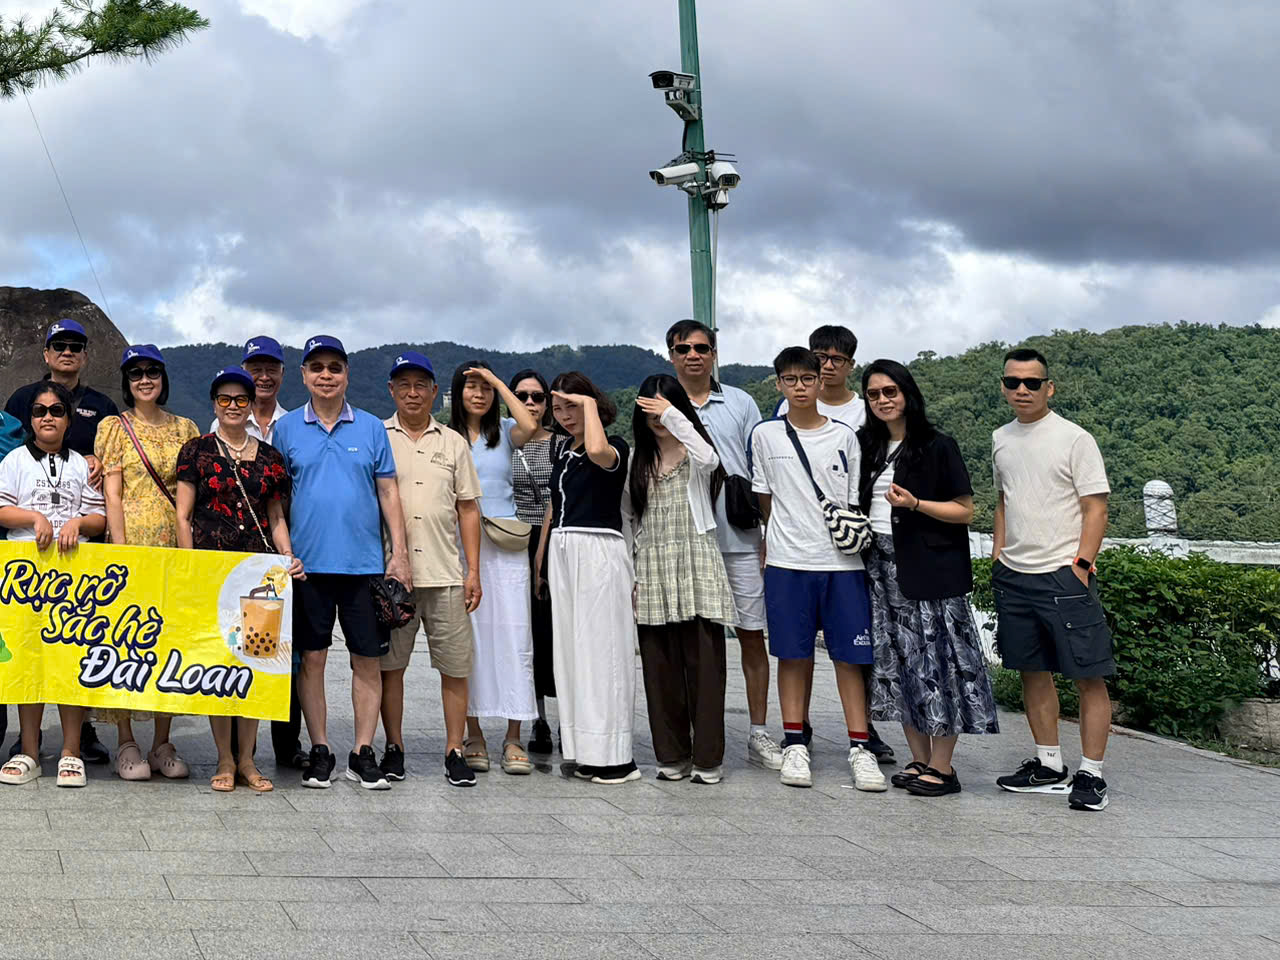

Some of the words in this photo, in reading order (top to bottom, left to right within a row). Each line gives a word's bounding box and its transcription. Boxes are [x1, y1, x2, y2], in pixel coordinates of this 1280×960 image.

[0, 560, 72, 611] Rực
[75, 564, 128, 606] rỡ
[112, 605, 163, 649] hè
[79, 644, 157, 691] Đài
[157, 648, 253, 698] Loan
